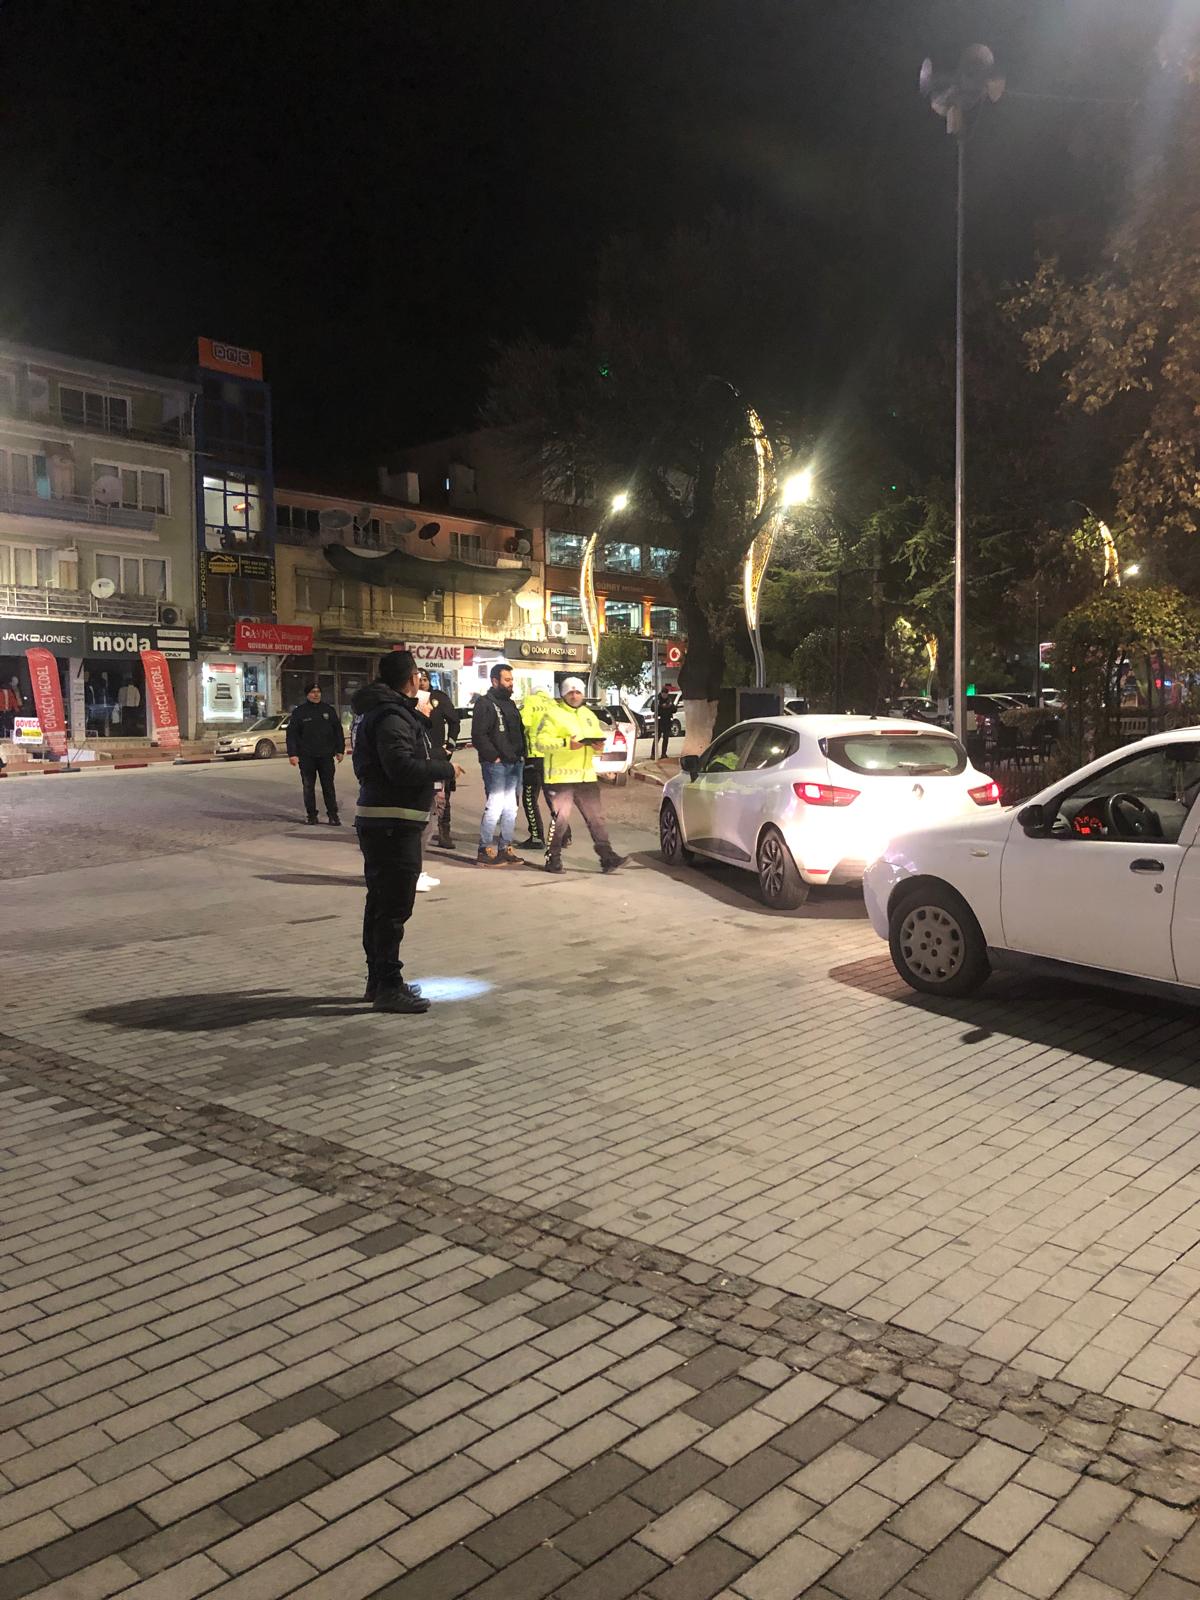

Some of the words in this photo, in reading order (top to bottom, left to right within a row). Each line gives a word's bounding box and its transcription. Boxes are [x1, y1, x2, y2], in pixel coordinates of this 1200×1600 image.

[3, 633, 29, 641] JACK
[41, 635, 72, 643] JONES
[93, 633, 150, 652] moda
[409, 645, 461, 660] ECZANE
